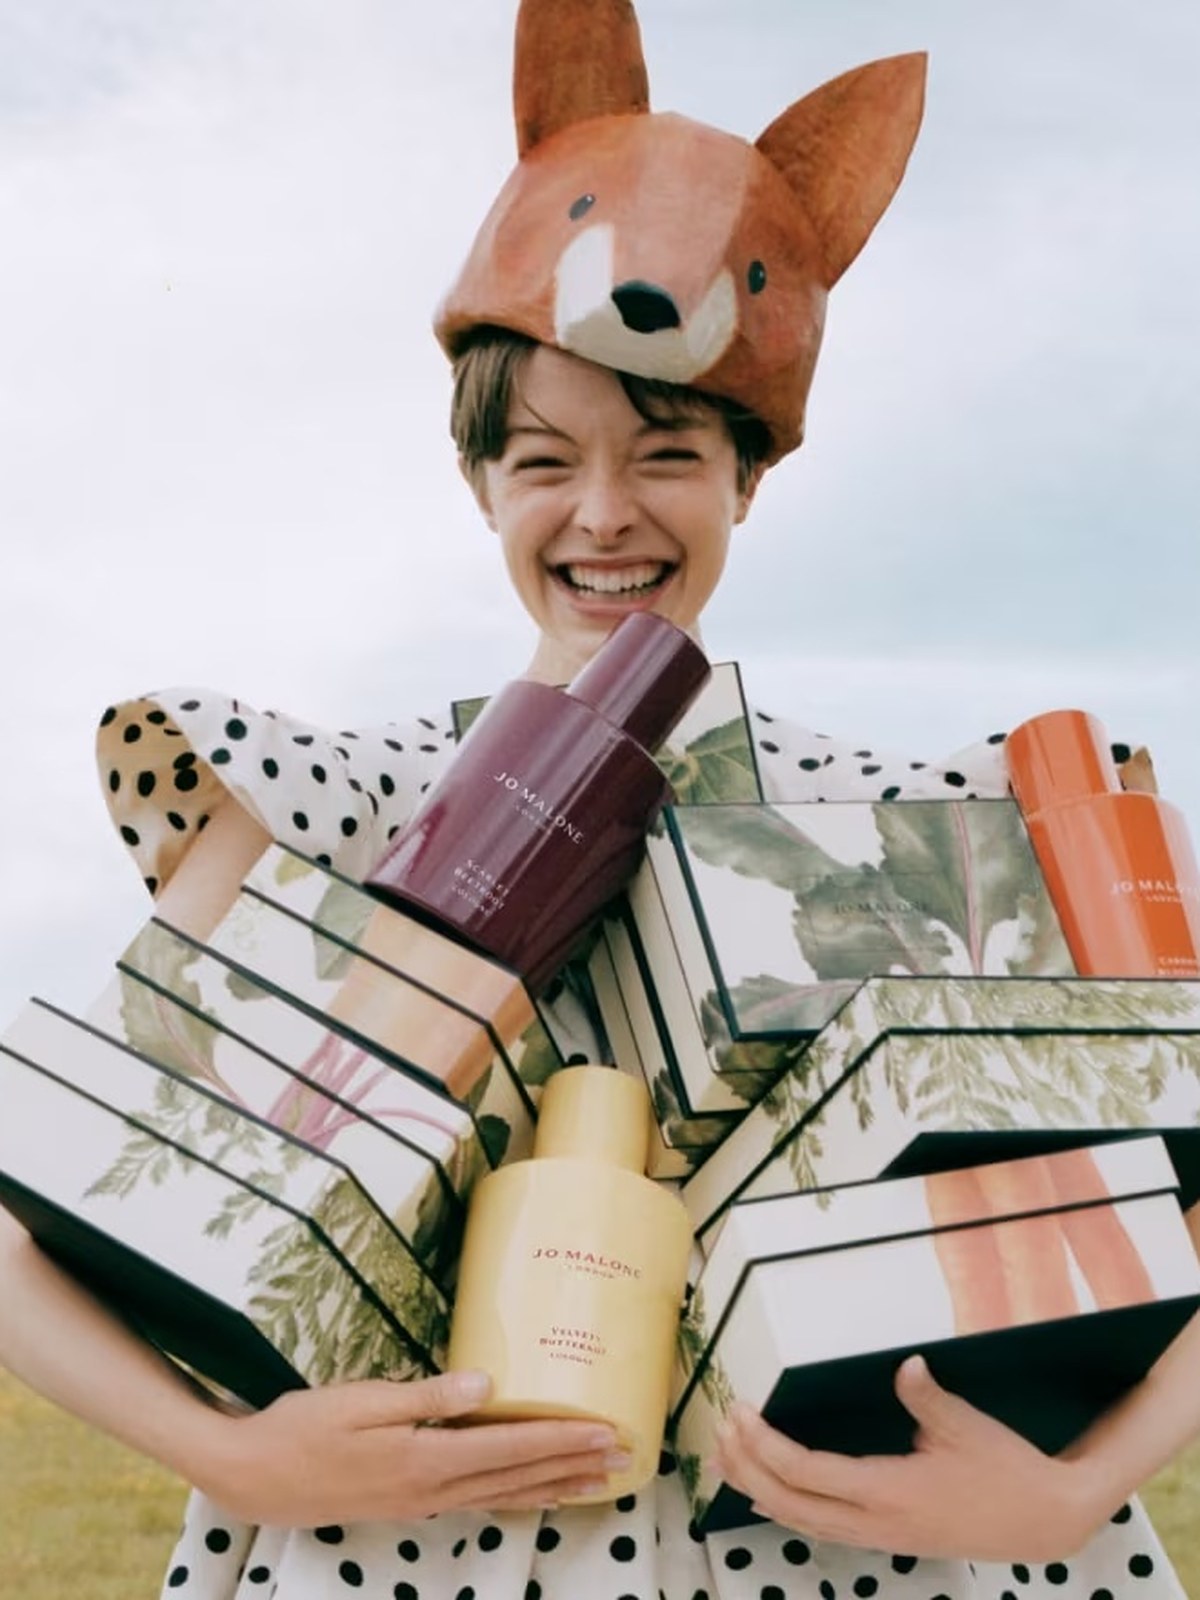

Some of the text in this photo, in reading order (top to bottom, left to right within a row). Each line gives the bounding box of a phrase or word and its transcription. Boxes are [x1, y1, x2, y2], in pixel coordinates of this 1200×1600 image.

[493, 772, 584, 844] JO MALONE
[1110, 881, 1134, 895] JO
[533, 1248, 641, 1279] JO MALONE
